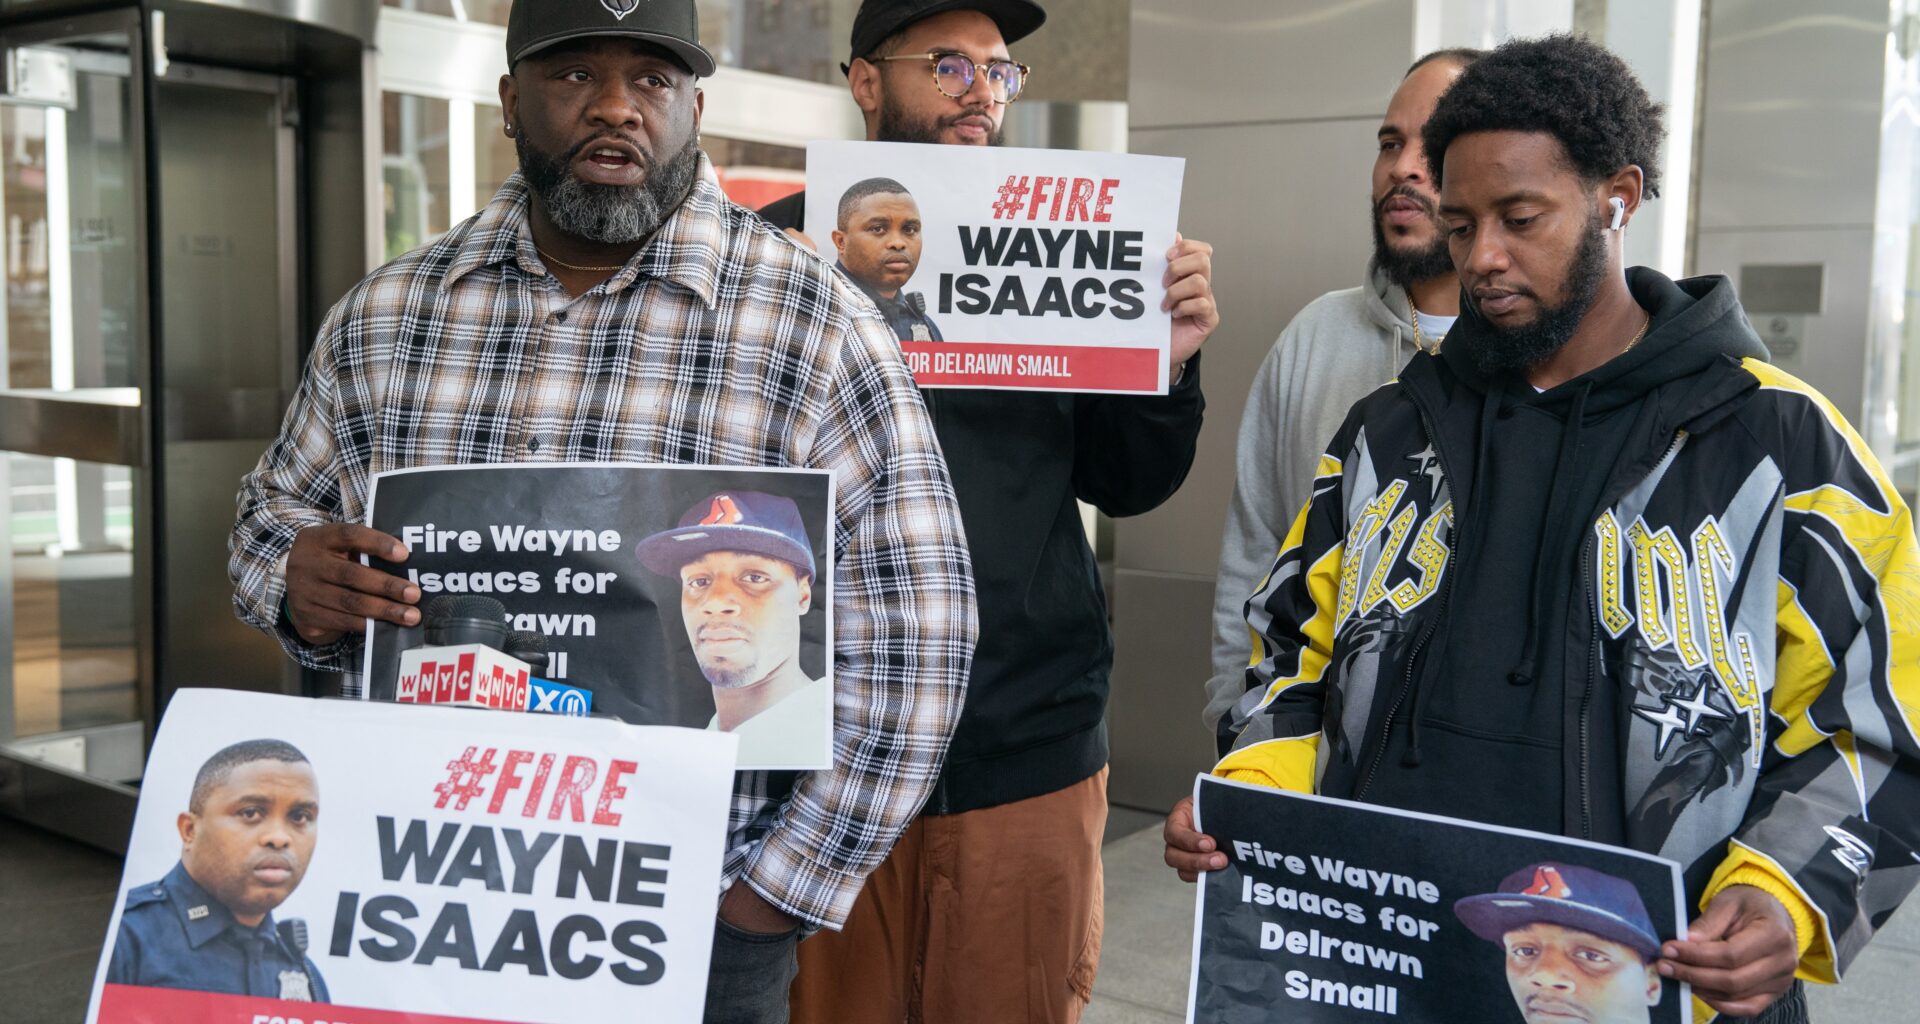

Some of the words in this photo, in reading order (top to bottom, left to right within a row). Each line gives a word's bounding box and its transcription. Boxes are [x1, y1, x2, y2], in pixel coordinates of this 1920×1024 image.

[991, 175, 1120, 223] #FIRE
[957, 225, 1144, 271] WAYNE
[938, 272, 1145, 320] ISAACS
[934, 352, 1012, 375] DELRAWN
[1017, 355, 1072, 377] SMALL
[402, 523, 482, 553] Fire
[490, 525, 622, 557] Wayne
[408, 568, 541, 593] Isaacs
[554, 568, 618, 594] for
[401, 669, 471, 694] WNYC
[478, 671, 525, 707] WNYC
[433, 745, 639, 828] #FIRE
[375, 815, 672, 909] WAYNE
[1232, 840, 1307, 876] Fire
[1310, 855, 1440, 904] Wayne
[1241, 875, 1367, 924] Isaacs
[1378, 907, 1441, 942] for
[328, 891, 668, 987] ISAACS
[1260, 921, 1424, 979] Delrawn
[1284, 970, 1398, 1015] Small
